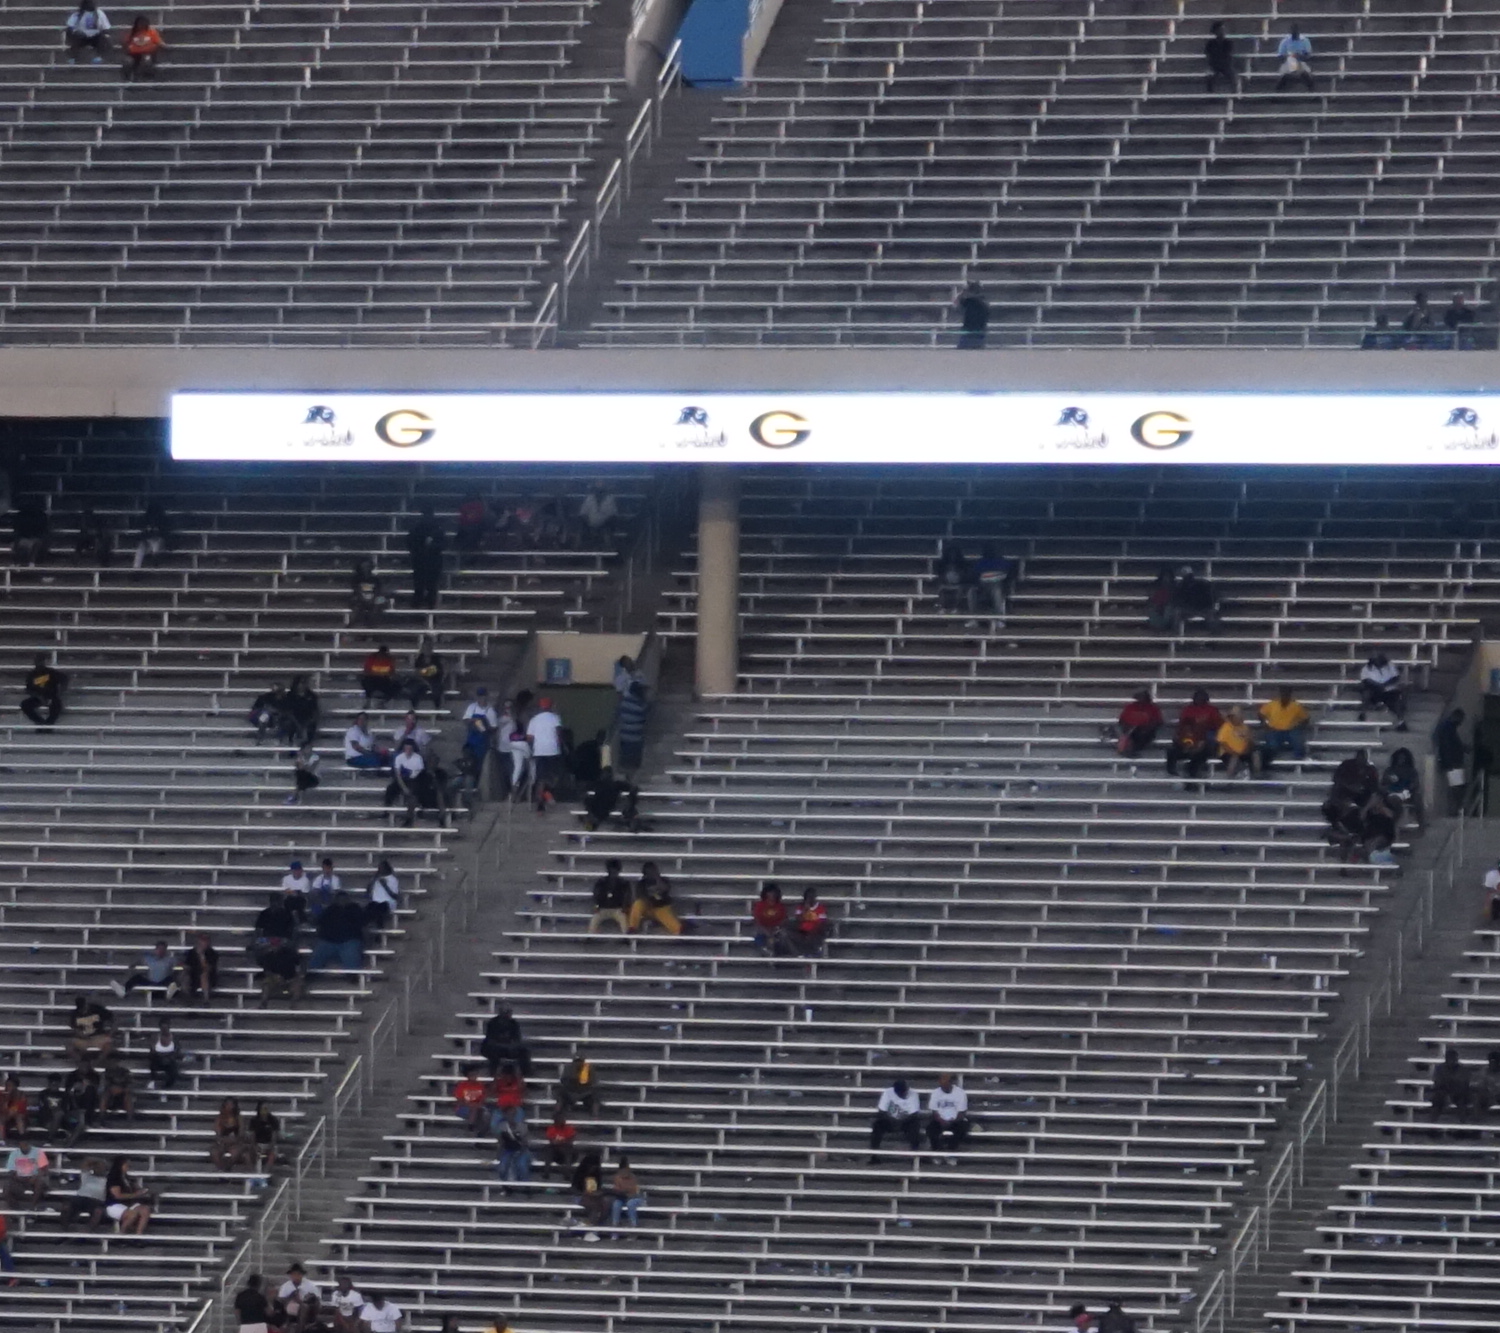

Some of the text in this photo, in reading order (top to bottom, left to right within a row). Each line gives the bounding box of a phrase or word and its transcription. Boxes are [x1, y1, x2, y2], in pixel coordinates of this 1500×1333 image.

[376, 409, 436, 447] G
[749, 410, 811, 448] G
[1131, 410, 1194, 451] G
